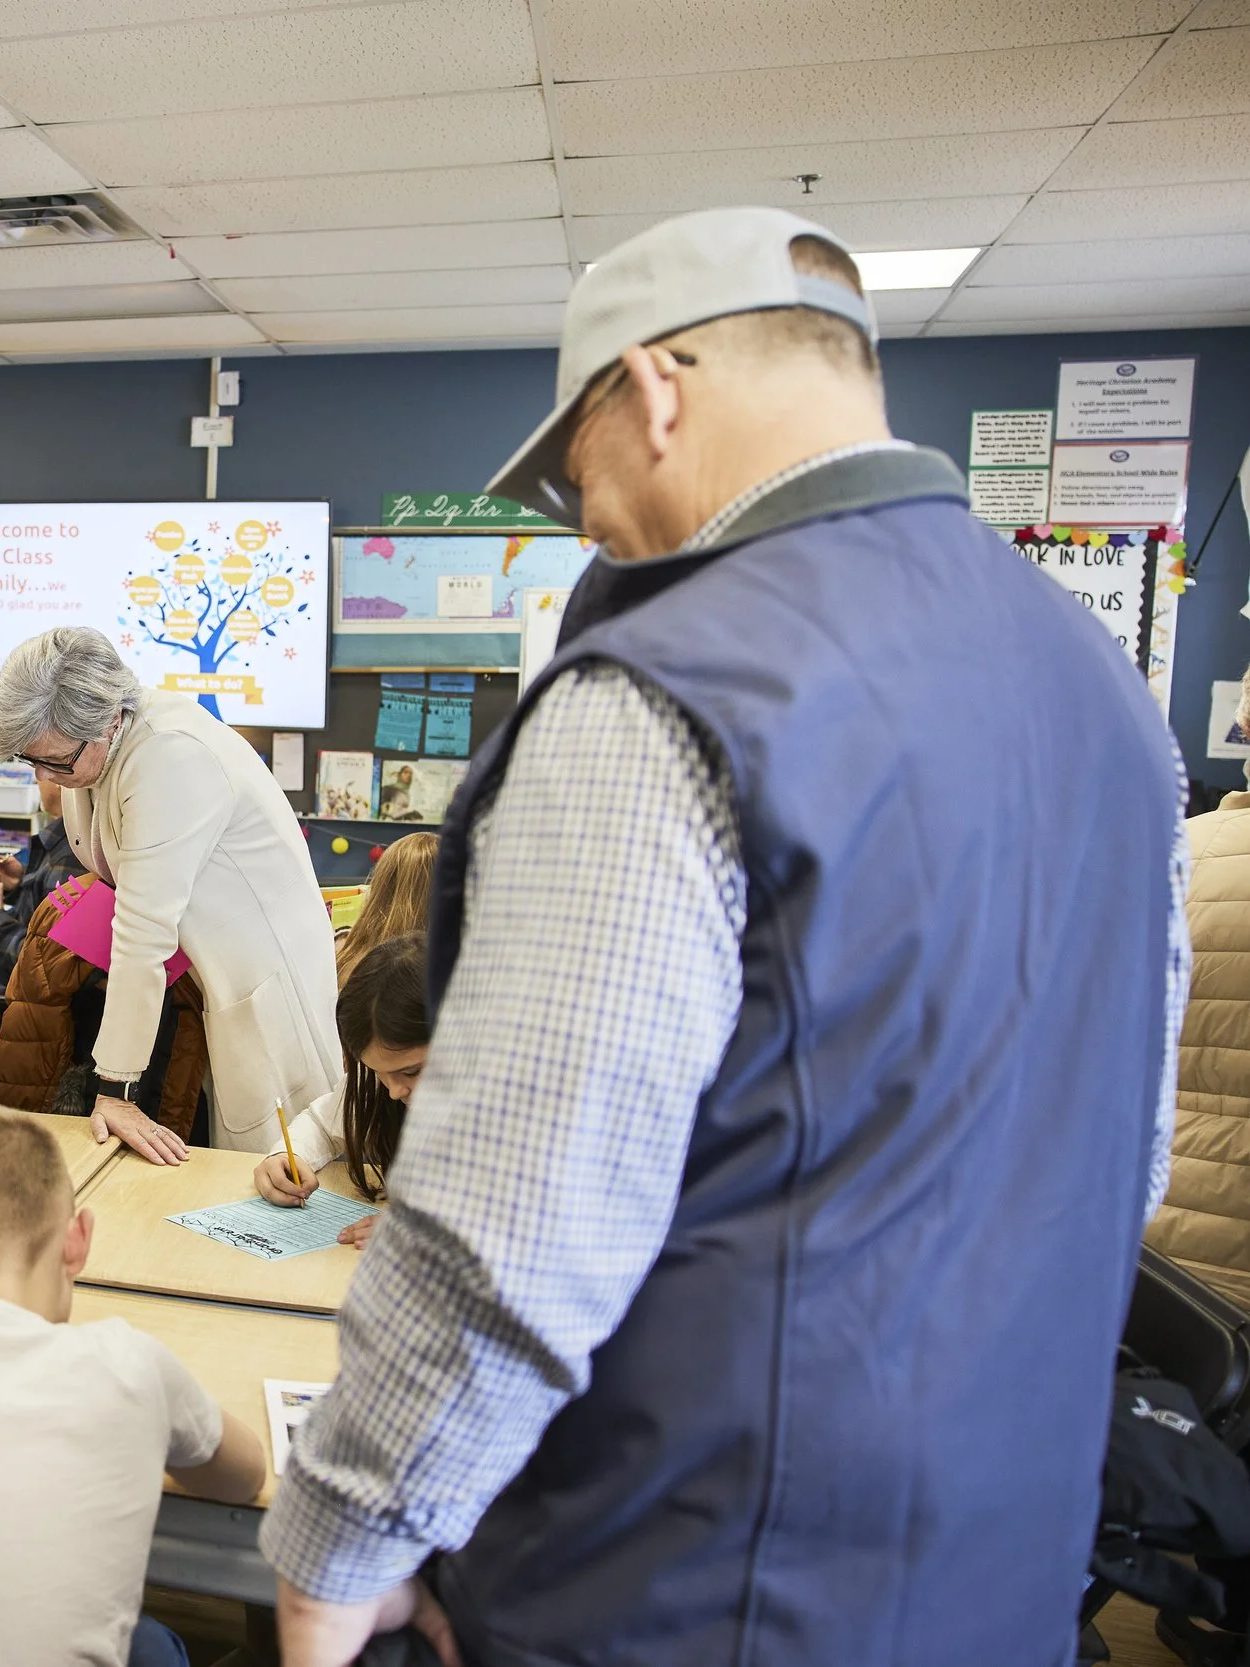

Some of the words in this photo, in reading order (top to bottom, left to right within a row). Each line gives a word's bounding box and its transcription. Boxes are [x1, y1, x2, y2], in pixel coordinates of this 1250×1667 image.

[389, 495, 420, 526] Pp
[466, 495, 502, 517] Rr
[59, 522, 79, 538] to
[3, 547, 53, 565] Class
[1060, 547, 1075, 566] IN
[1084, 546, 1125, 567] LOVE
[7, 600, 34, 611] glad
[37, 601, 59, 611] you
[62, 601, 82, 609] are
[1101, 591, 1123, 611] US
[176, 677, 206, 689] What
[207, 678, 221, 689] to
[224, 678, 244, 690] do?
